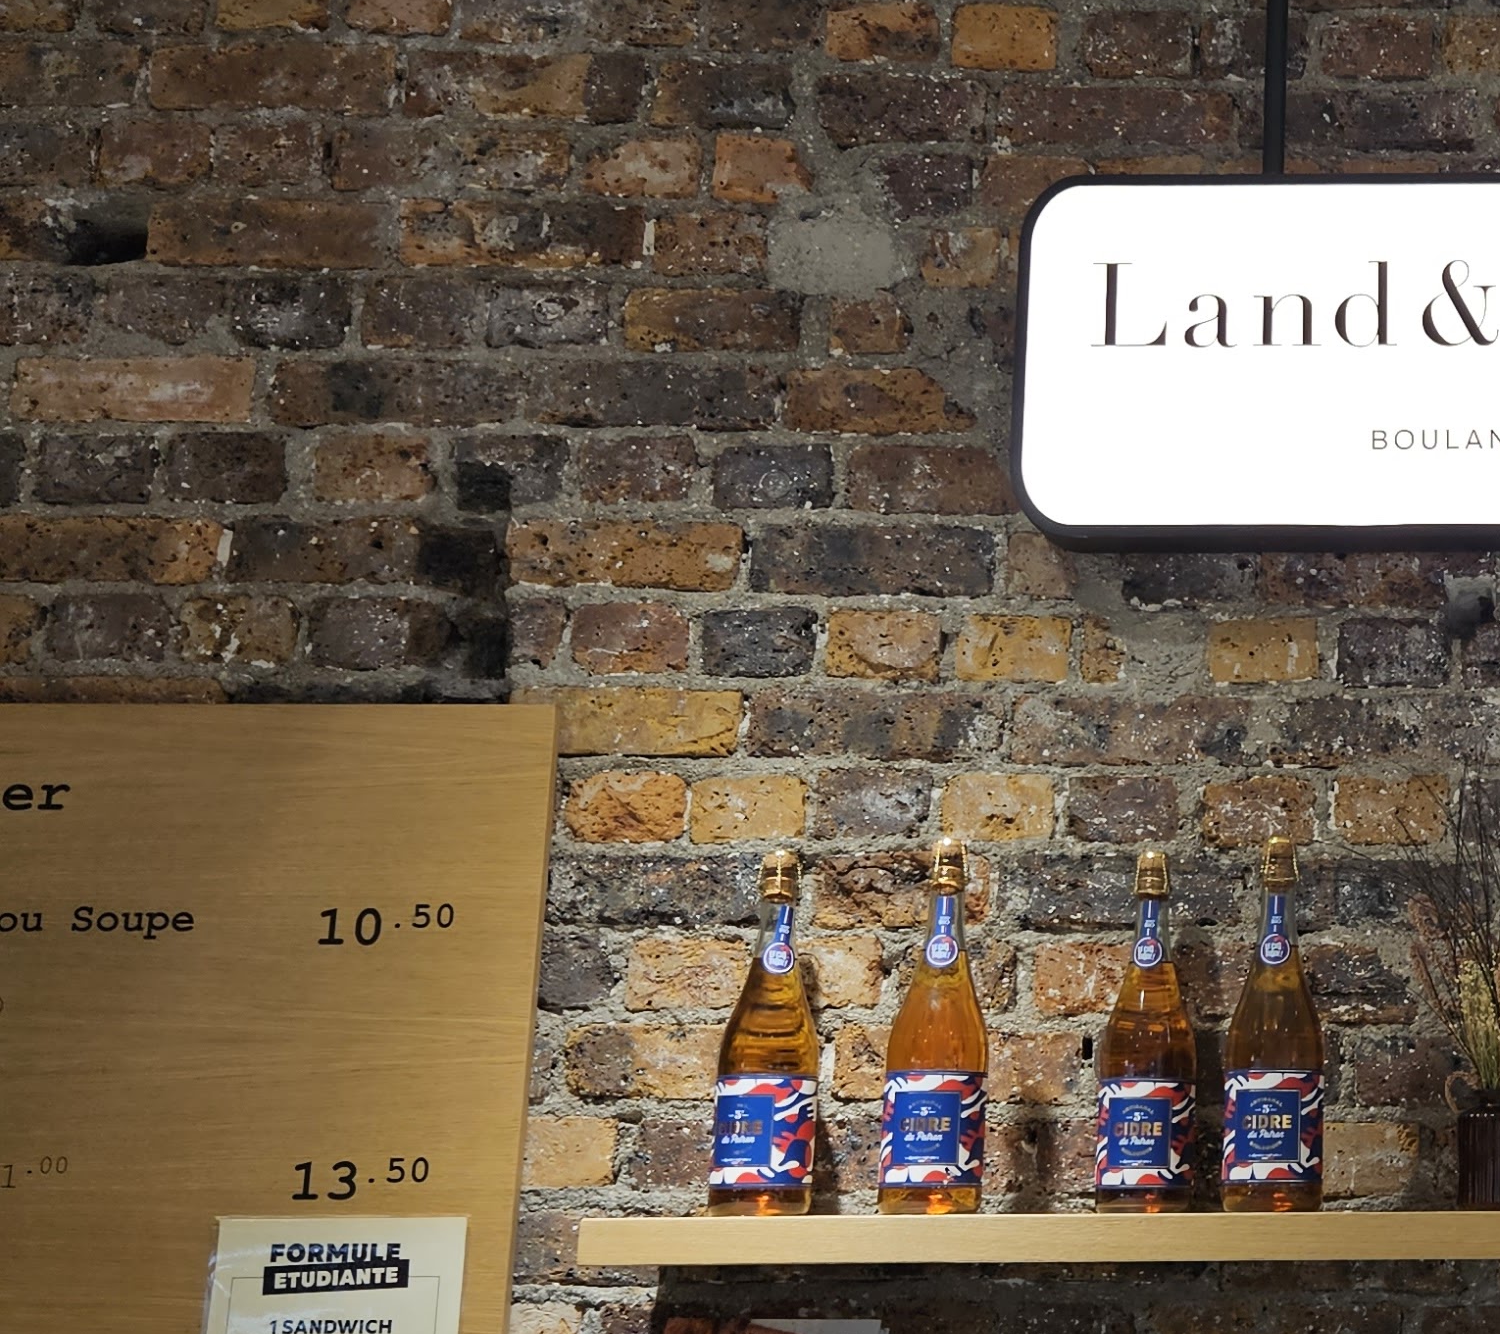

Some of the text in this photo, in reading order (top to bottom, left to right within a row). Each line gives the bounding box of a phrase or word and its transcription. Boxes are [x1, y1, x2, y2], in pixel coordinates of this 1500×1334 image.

[70, 905, 195, 941] Soupe
[317, 903, 455, 946] 10.50
[899, 1117, 952, 1133] CIDRE
[1114, 1121, 1162, 1136] CIDRE
[1242, 1115, 1292, 1130] CIDRE
[1259, 1129, 1285, 1139] Patron
[291, 1156, 429, 1201] 13.50
[269, 1242, 403, 1265] FORMULE
[273, 1266, 401, 1291] ETUDIANTE
